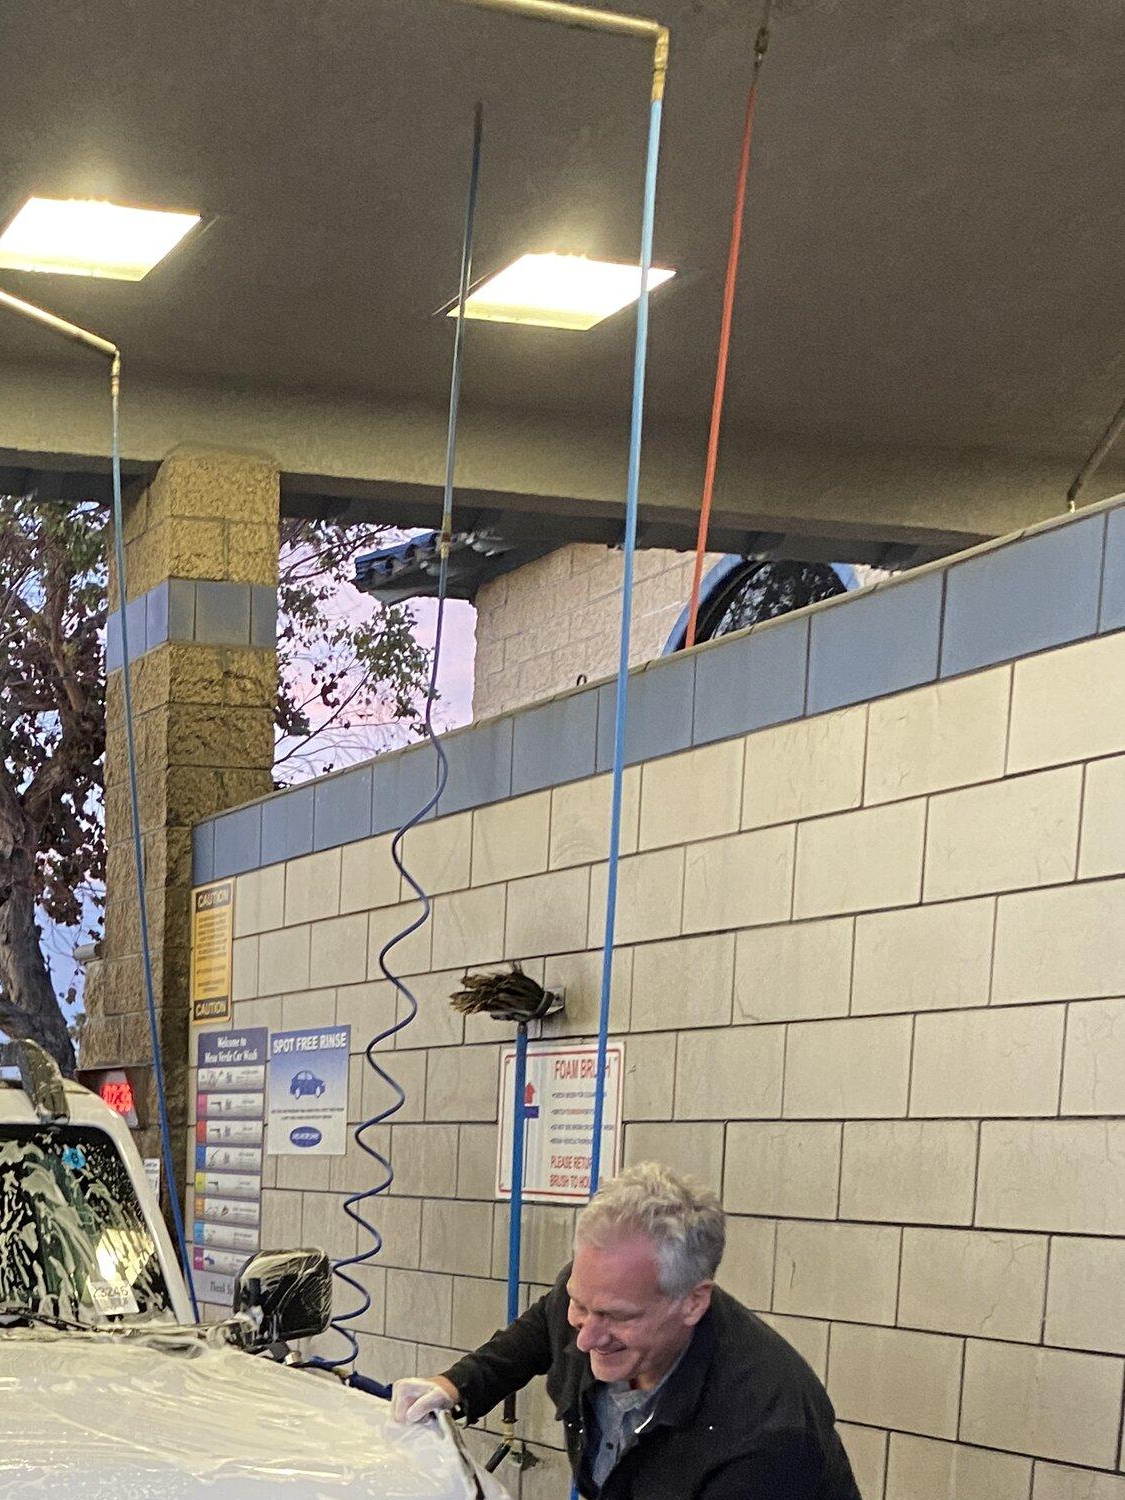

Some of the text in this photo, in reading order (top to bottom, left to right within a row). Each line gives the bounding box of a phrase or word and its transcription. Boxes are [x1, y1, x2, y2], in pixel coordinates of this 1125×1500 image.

[197, 888, 229, 908] CAUTION
[195, 1001, 227, 1017] CAUTION
[273, 1032, 347, 1054] SPOT FREE RINSE
[555, 1057, 611, 1080] FOAM BRH
[551, 1155, 573, 1169] PLEASE
